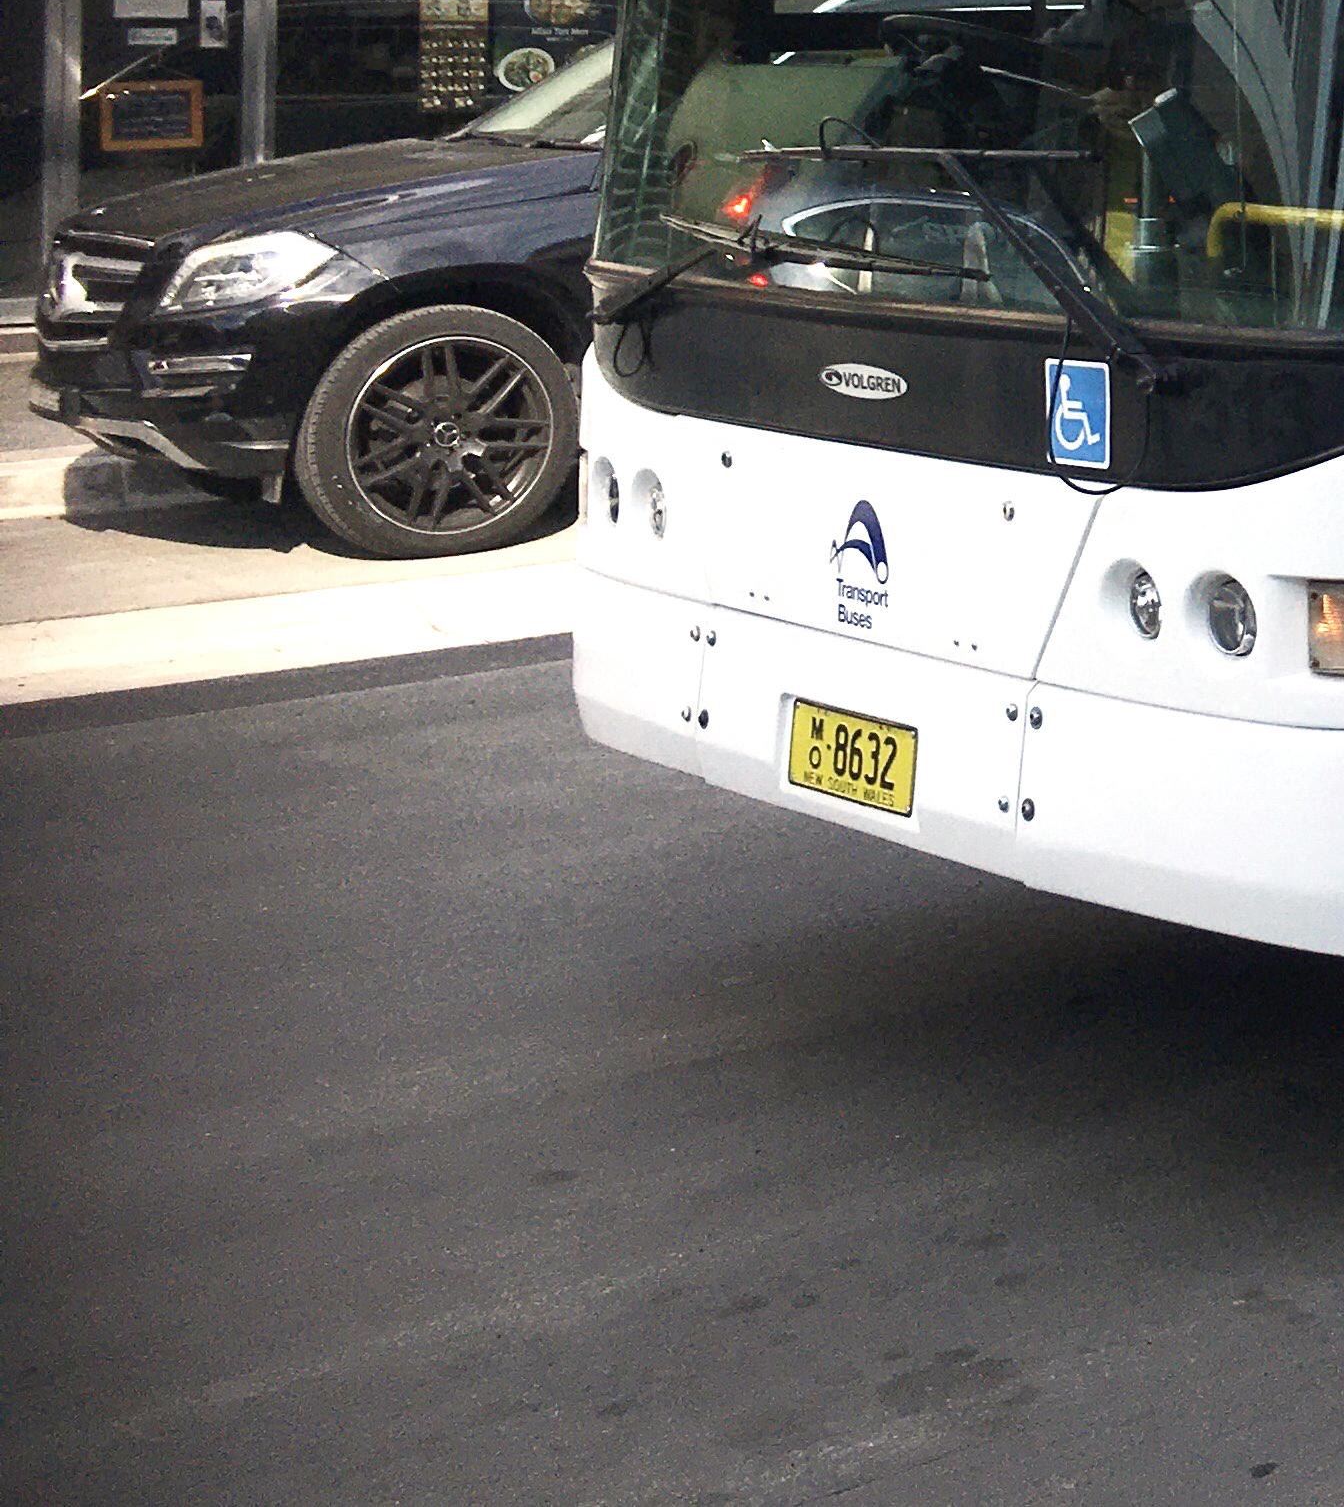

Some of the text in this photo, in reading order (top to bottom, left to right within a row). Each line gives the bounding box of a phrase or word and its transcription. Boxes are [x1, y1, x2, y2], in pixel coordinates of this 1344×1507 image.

[842, 370, 902, 395] VOLGREN
[835, 578, 889, 609] Transport
[837, 603, 873, 631] Buses
[832, 723, 898, 792] 8632
[803, 770, 895, 808] NEW SOUTH WALES
